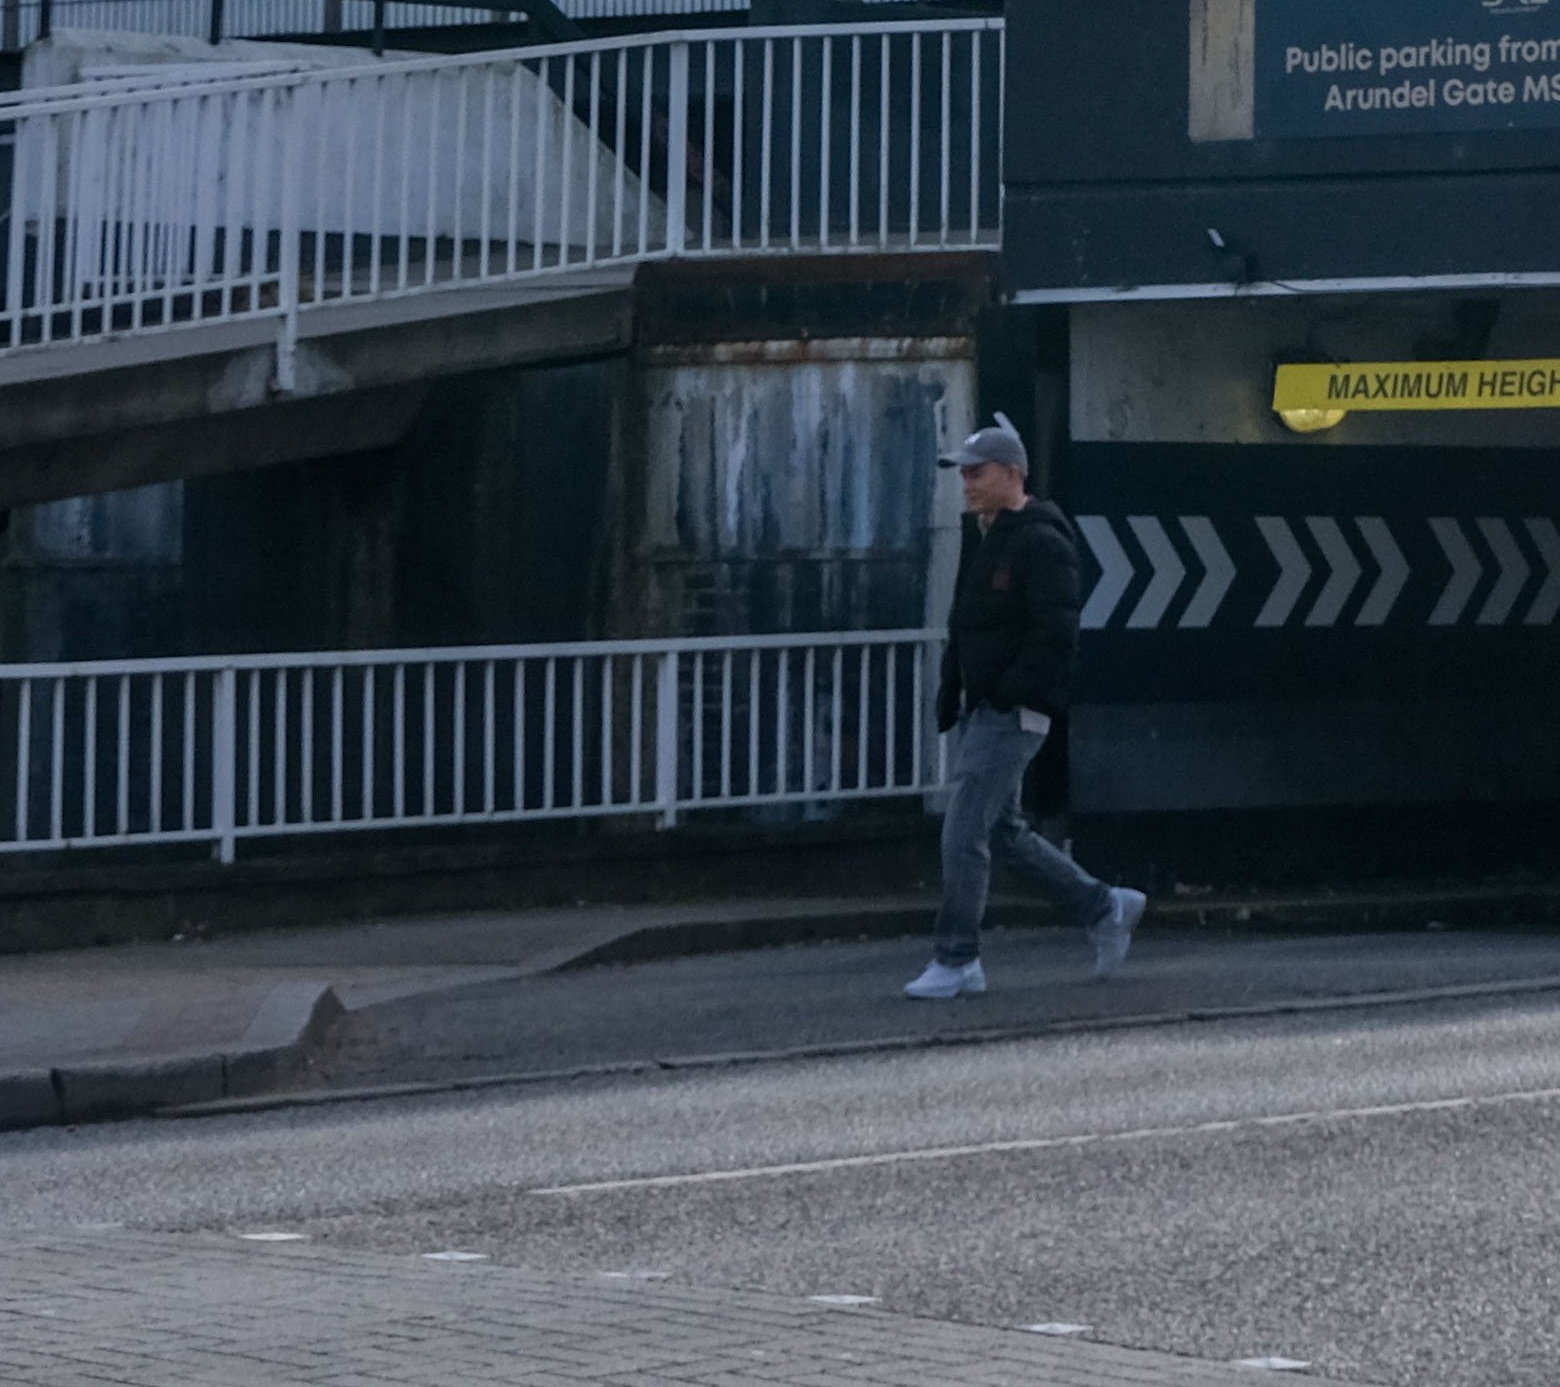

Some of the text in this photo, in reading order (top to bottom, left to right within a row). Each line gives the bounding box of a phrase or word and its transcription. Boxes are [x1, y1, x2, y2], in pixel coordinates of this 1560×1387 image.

[1285, 41, 1373, 75] Public
[1380, 36, 1492, 76] parking
[1324, 80, 1436, 112] Arundel
[1442, 79, 1516, 107] Gate
[1327, 371, 1470, 401] MAXIMUM
